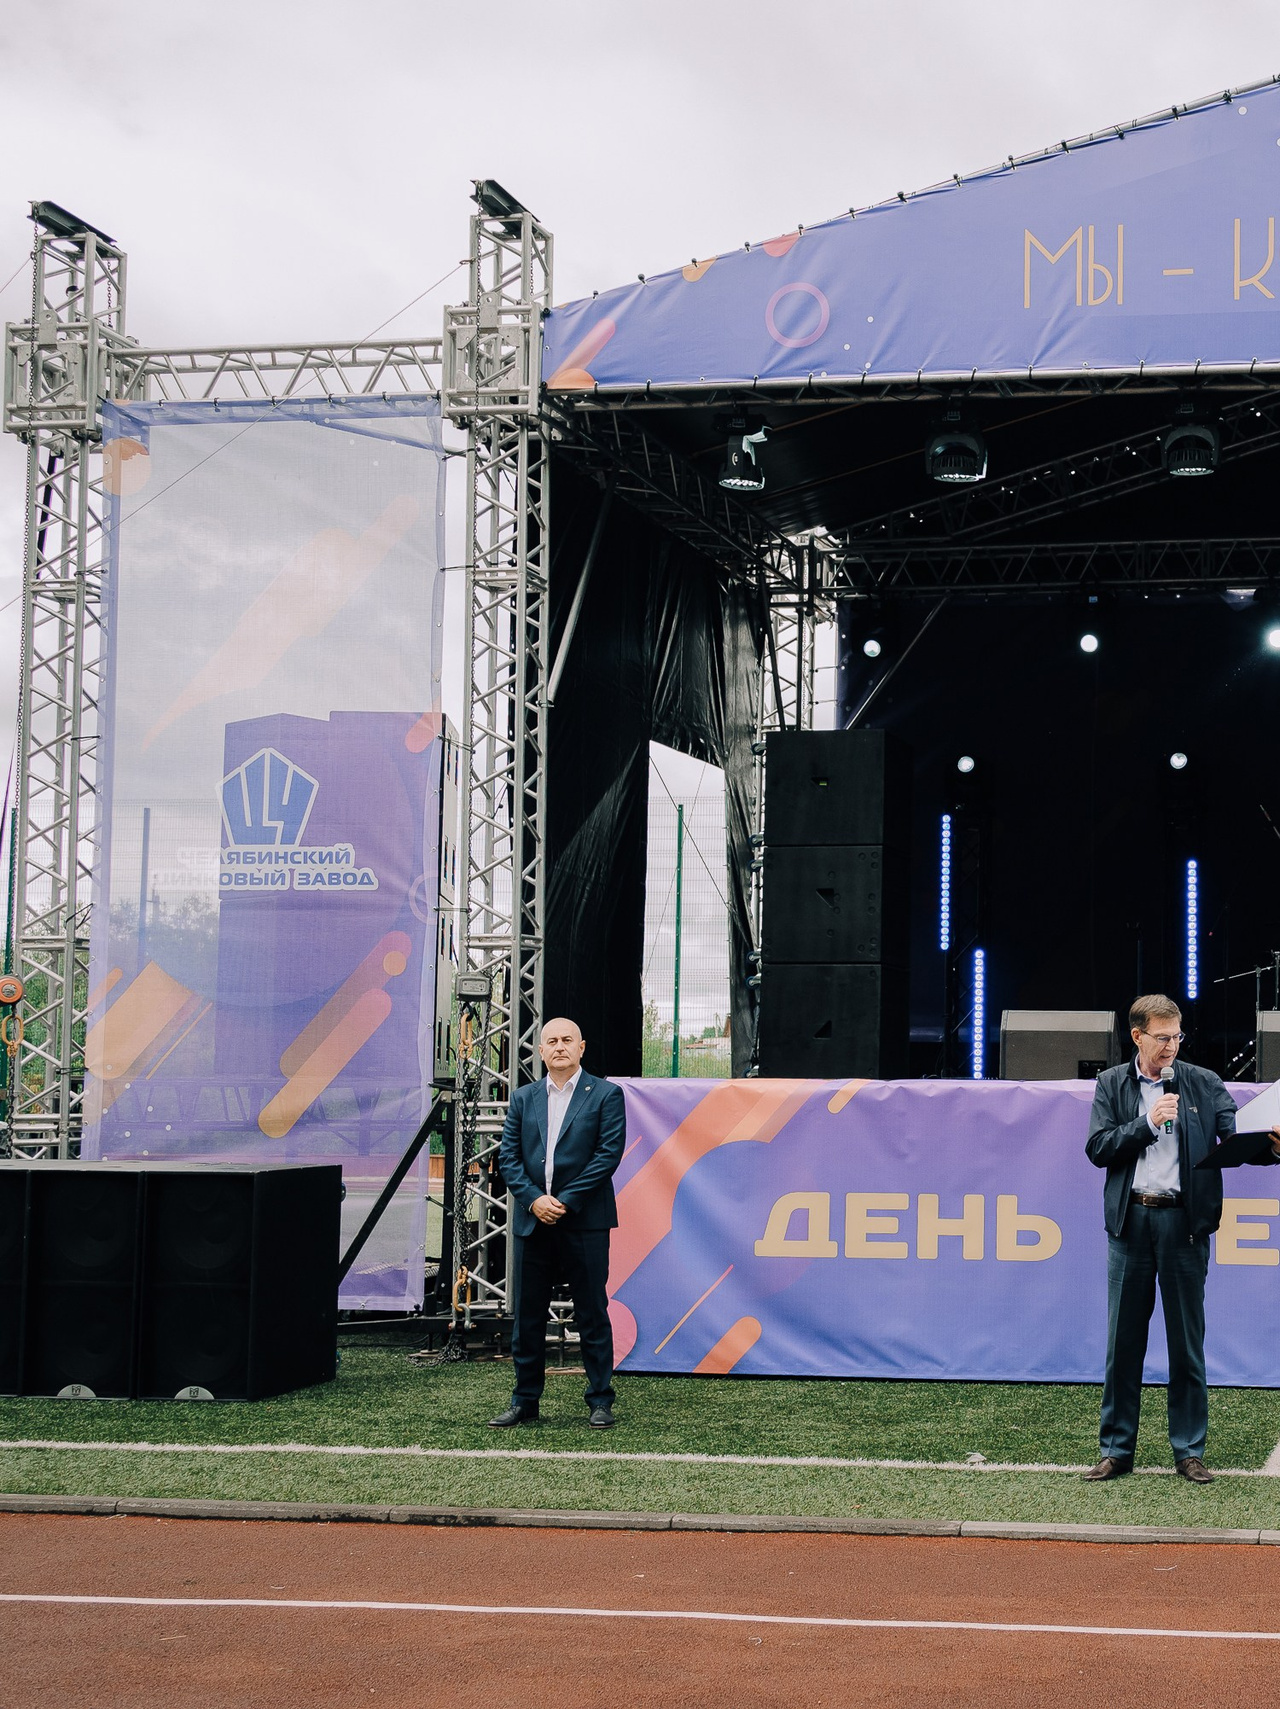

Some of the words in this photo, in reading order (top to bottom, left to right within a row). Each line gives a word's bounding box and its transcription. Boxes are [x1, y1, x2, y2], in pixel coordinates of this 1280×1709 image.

[1024, 223, 1124, 309] МЫ
[297, 872, 375, 886] ЗАВОД
[754, 1191, 1062, 1262] ДЕНЬ
